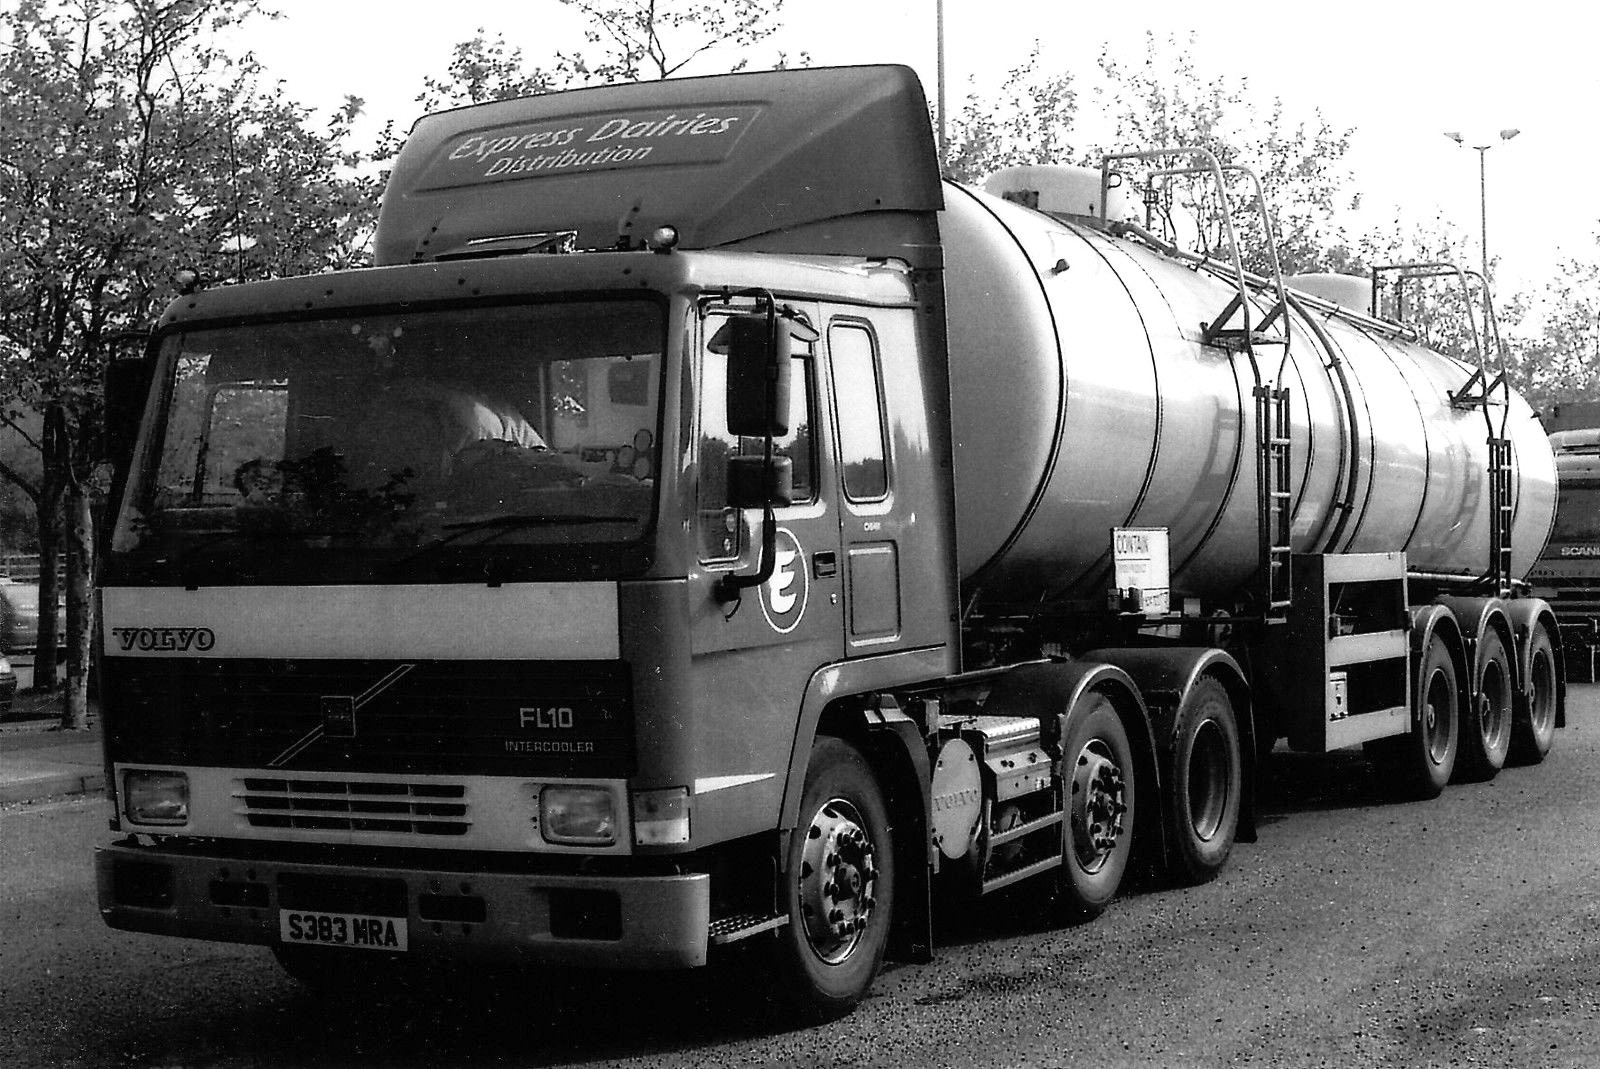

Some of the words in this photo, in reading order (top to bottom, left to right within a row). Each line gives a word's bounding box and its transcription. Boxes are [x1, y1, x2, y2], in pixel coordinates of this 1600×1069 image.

[449, 127, 583, 163] Express
[586, 112, 739, 143] Dairies
[484, 145, 653, 176] Distribution
[112, 627, 215, 651] VOLVO
[519, 707, 573, 728] FL10
[504, 740, 594, 753] INTERCOOLER
[288, 913, 348, 943] S383
[352, 917, 399, 947] MRA
